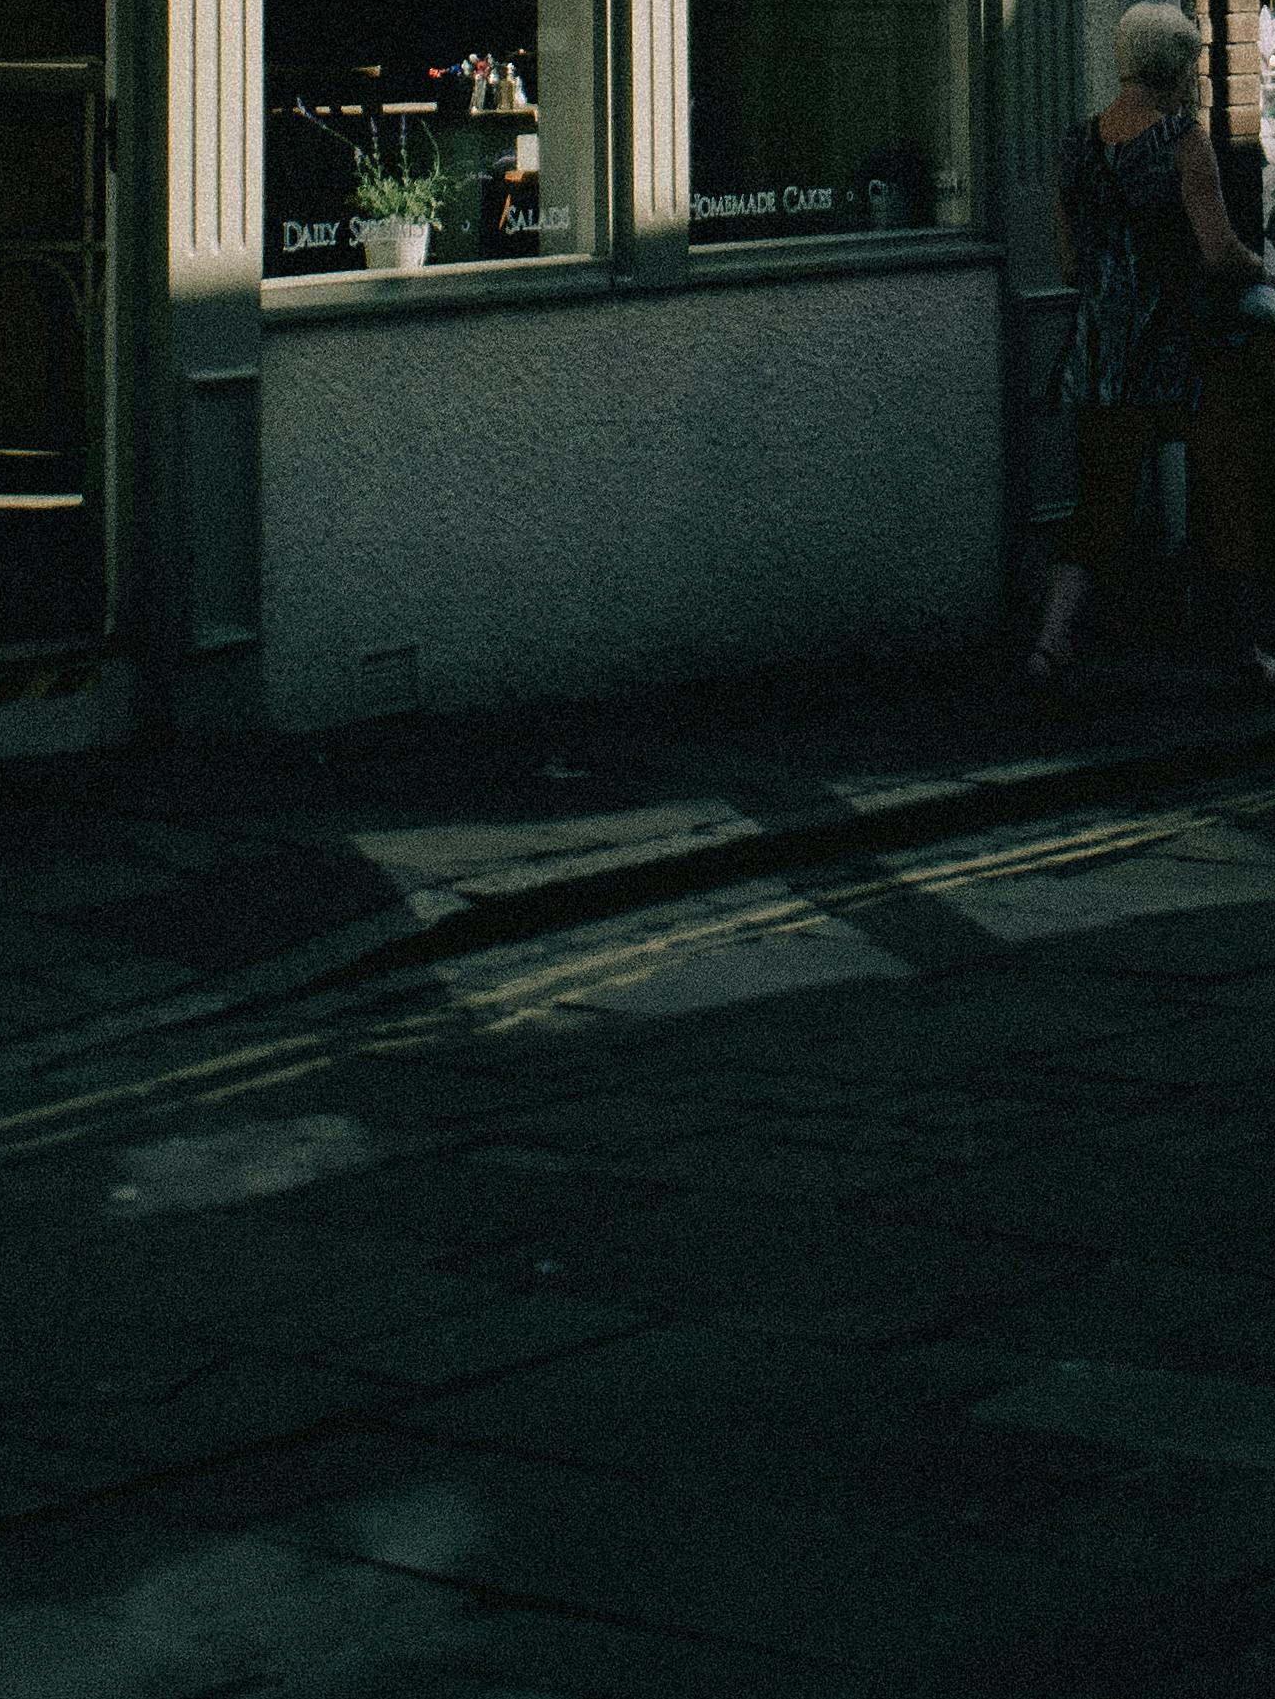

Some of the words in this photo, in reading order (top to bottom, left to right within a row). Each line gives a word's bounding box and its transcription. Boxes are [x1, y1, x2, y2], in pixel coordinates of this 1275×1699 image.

[690, 188, 777, 221] HOMEMADE
[781, 184, 834, 215] CAKES
[281, 219, 340, 254] DAILY
[505, 204, 570, 236] SALADS
